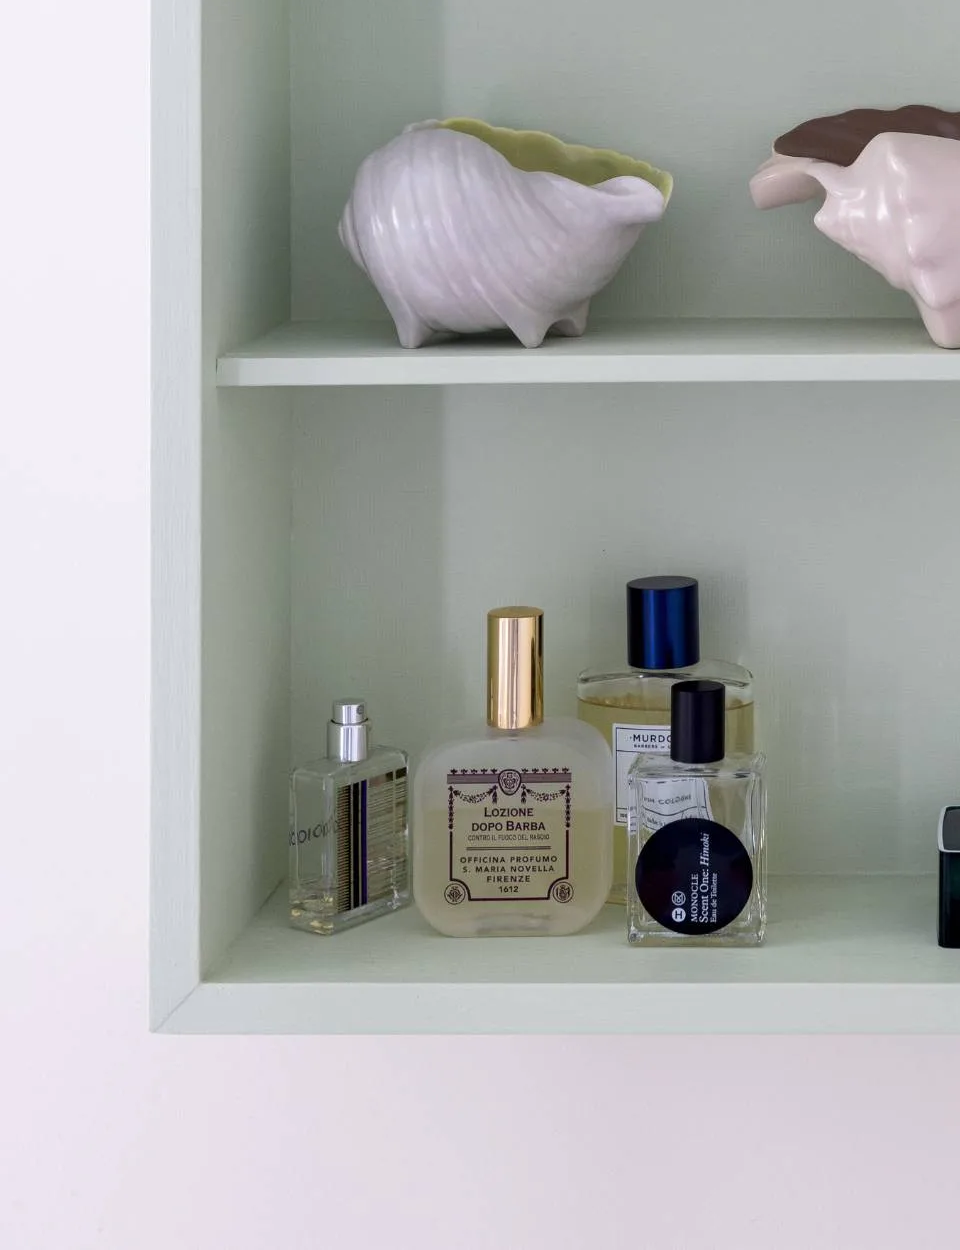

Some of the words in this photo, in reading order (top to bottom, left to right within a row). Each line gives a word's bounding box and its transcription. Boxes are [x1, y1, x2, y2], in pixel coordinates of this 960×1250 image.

[484, 807, 535, 818] LOZIONE
[471, 822, 504, 832] DOPO
[506, 820, 546, 832] BARBA
[517, 833, 529, 841] DEL
[700, 832, 710, 867] Hinoki
[459, 856, 506, 864] OFFICINA
[509, 855, 558, 863] PROFUMO
[462, 865, 471, 873] S.
[510, 865, 555, 873] NOVELLA
[486, 875, 532, 883] FIRENZE
[699, 868, 710, 893] One:
[498, 885, 519, 893] 1612
[710, 872, 718, 898] Toilette
[690, 873, 699, 923] MONOCLE
[710, 898, 718, 908] de
[699, 894, 709, 924] Scent
[709, 907, 718, 924] Eau
